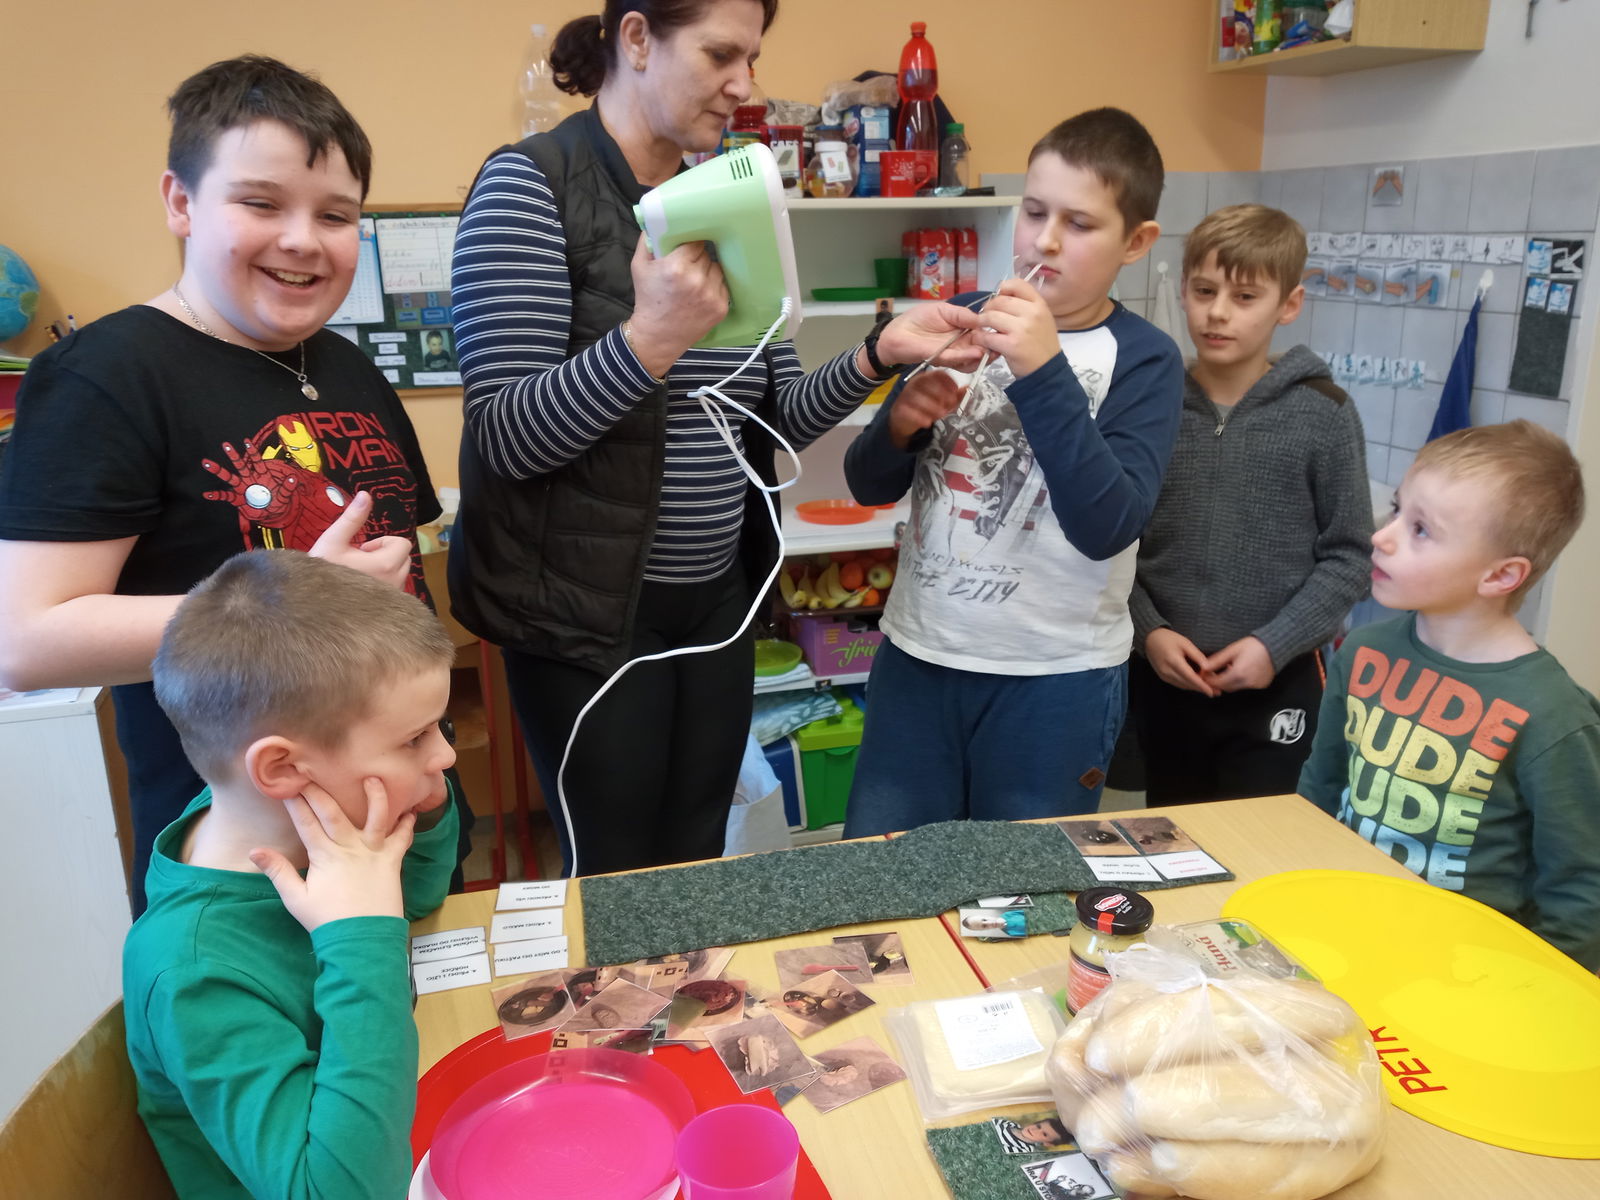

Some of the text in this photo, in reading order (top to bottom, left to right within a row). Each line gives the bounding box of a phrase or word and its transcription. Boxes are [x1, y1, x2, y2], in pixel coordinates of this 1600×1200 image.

[303, 411, 387, 439] IRON
[323, 438, 408, 470] MAN
[947, 577, 1020, 604] CITY
[1347, 646, 1530, 761] DUDE
[1344, 694, 1500, 801] DUDE
[1348, 750, 1485, 846] UDE
